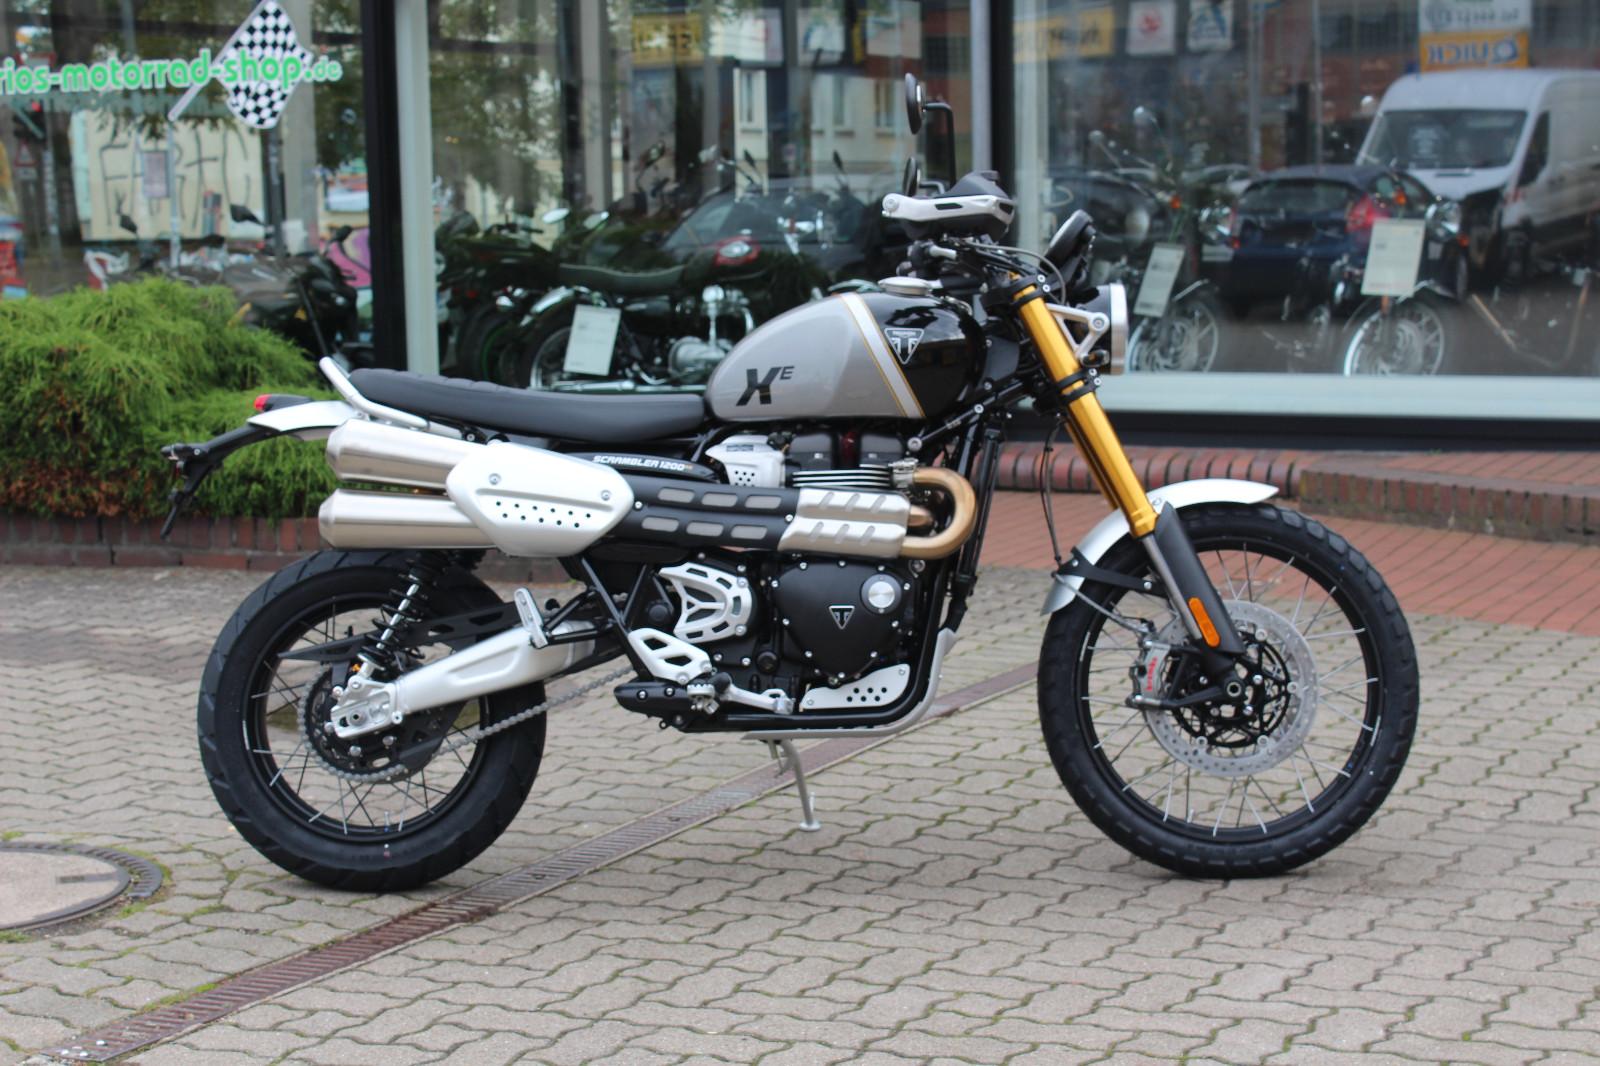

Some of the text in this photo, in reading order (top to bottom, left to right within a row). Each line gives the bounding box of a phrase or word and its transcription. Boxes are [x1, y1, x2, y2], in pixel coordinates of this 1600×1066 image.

[0, 48, 342, 95] ios-motorrad-shop.de
[593, 455, 658, 468] SCRAMBLER
[659, 460, 685, 471] 1200
